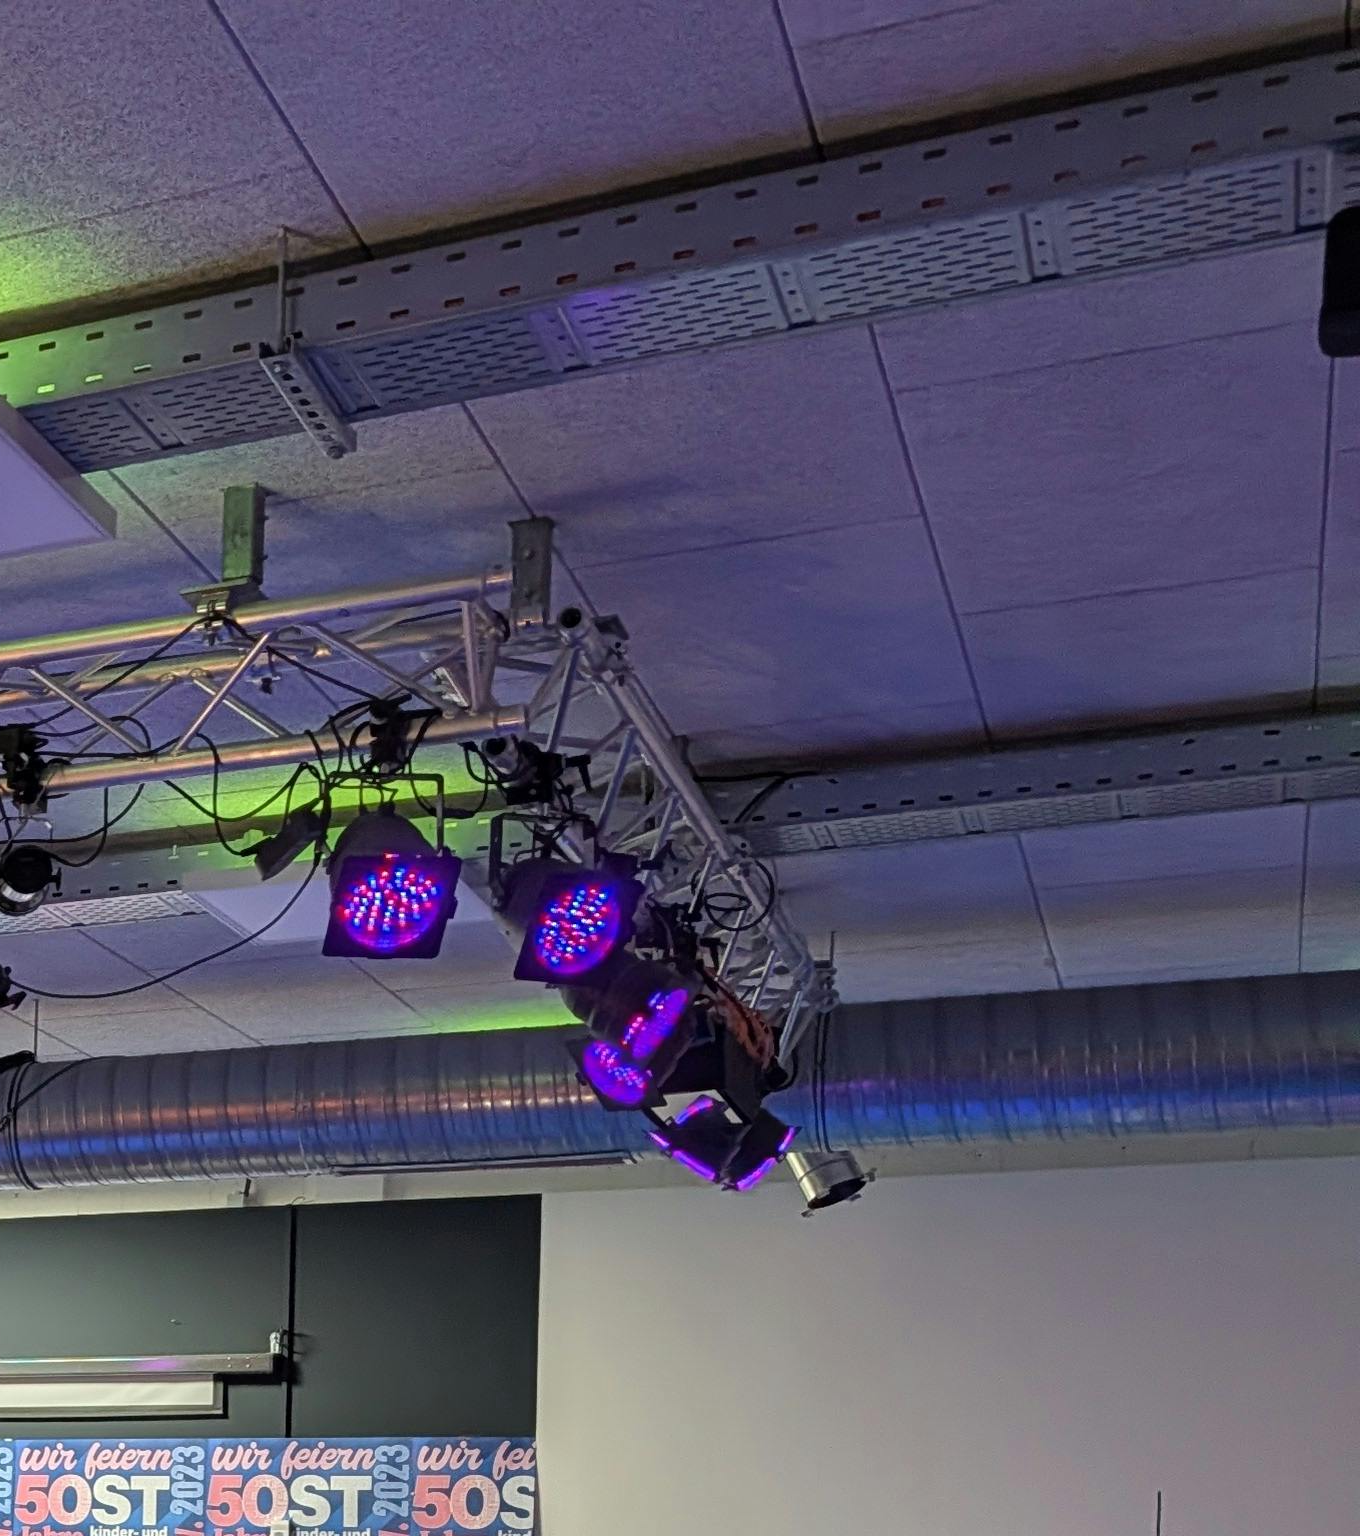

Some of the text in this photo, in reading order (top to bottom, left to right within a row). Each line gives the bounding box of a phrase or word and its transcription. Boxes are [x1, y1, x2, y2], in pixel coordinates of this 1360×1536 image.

[19, 1442, 174, 1479] wir feiern
[212, 1441, 376, 1481] wir feiern
[417, 1441, 483, 1471] wir
[170, 1445, 205, 1516] 2023
[372, 1445, 409, 1517] 2023
